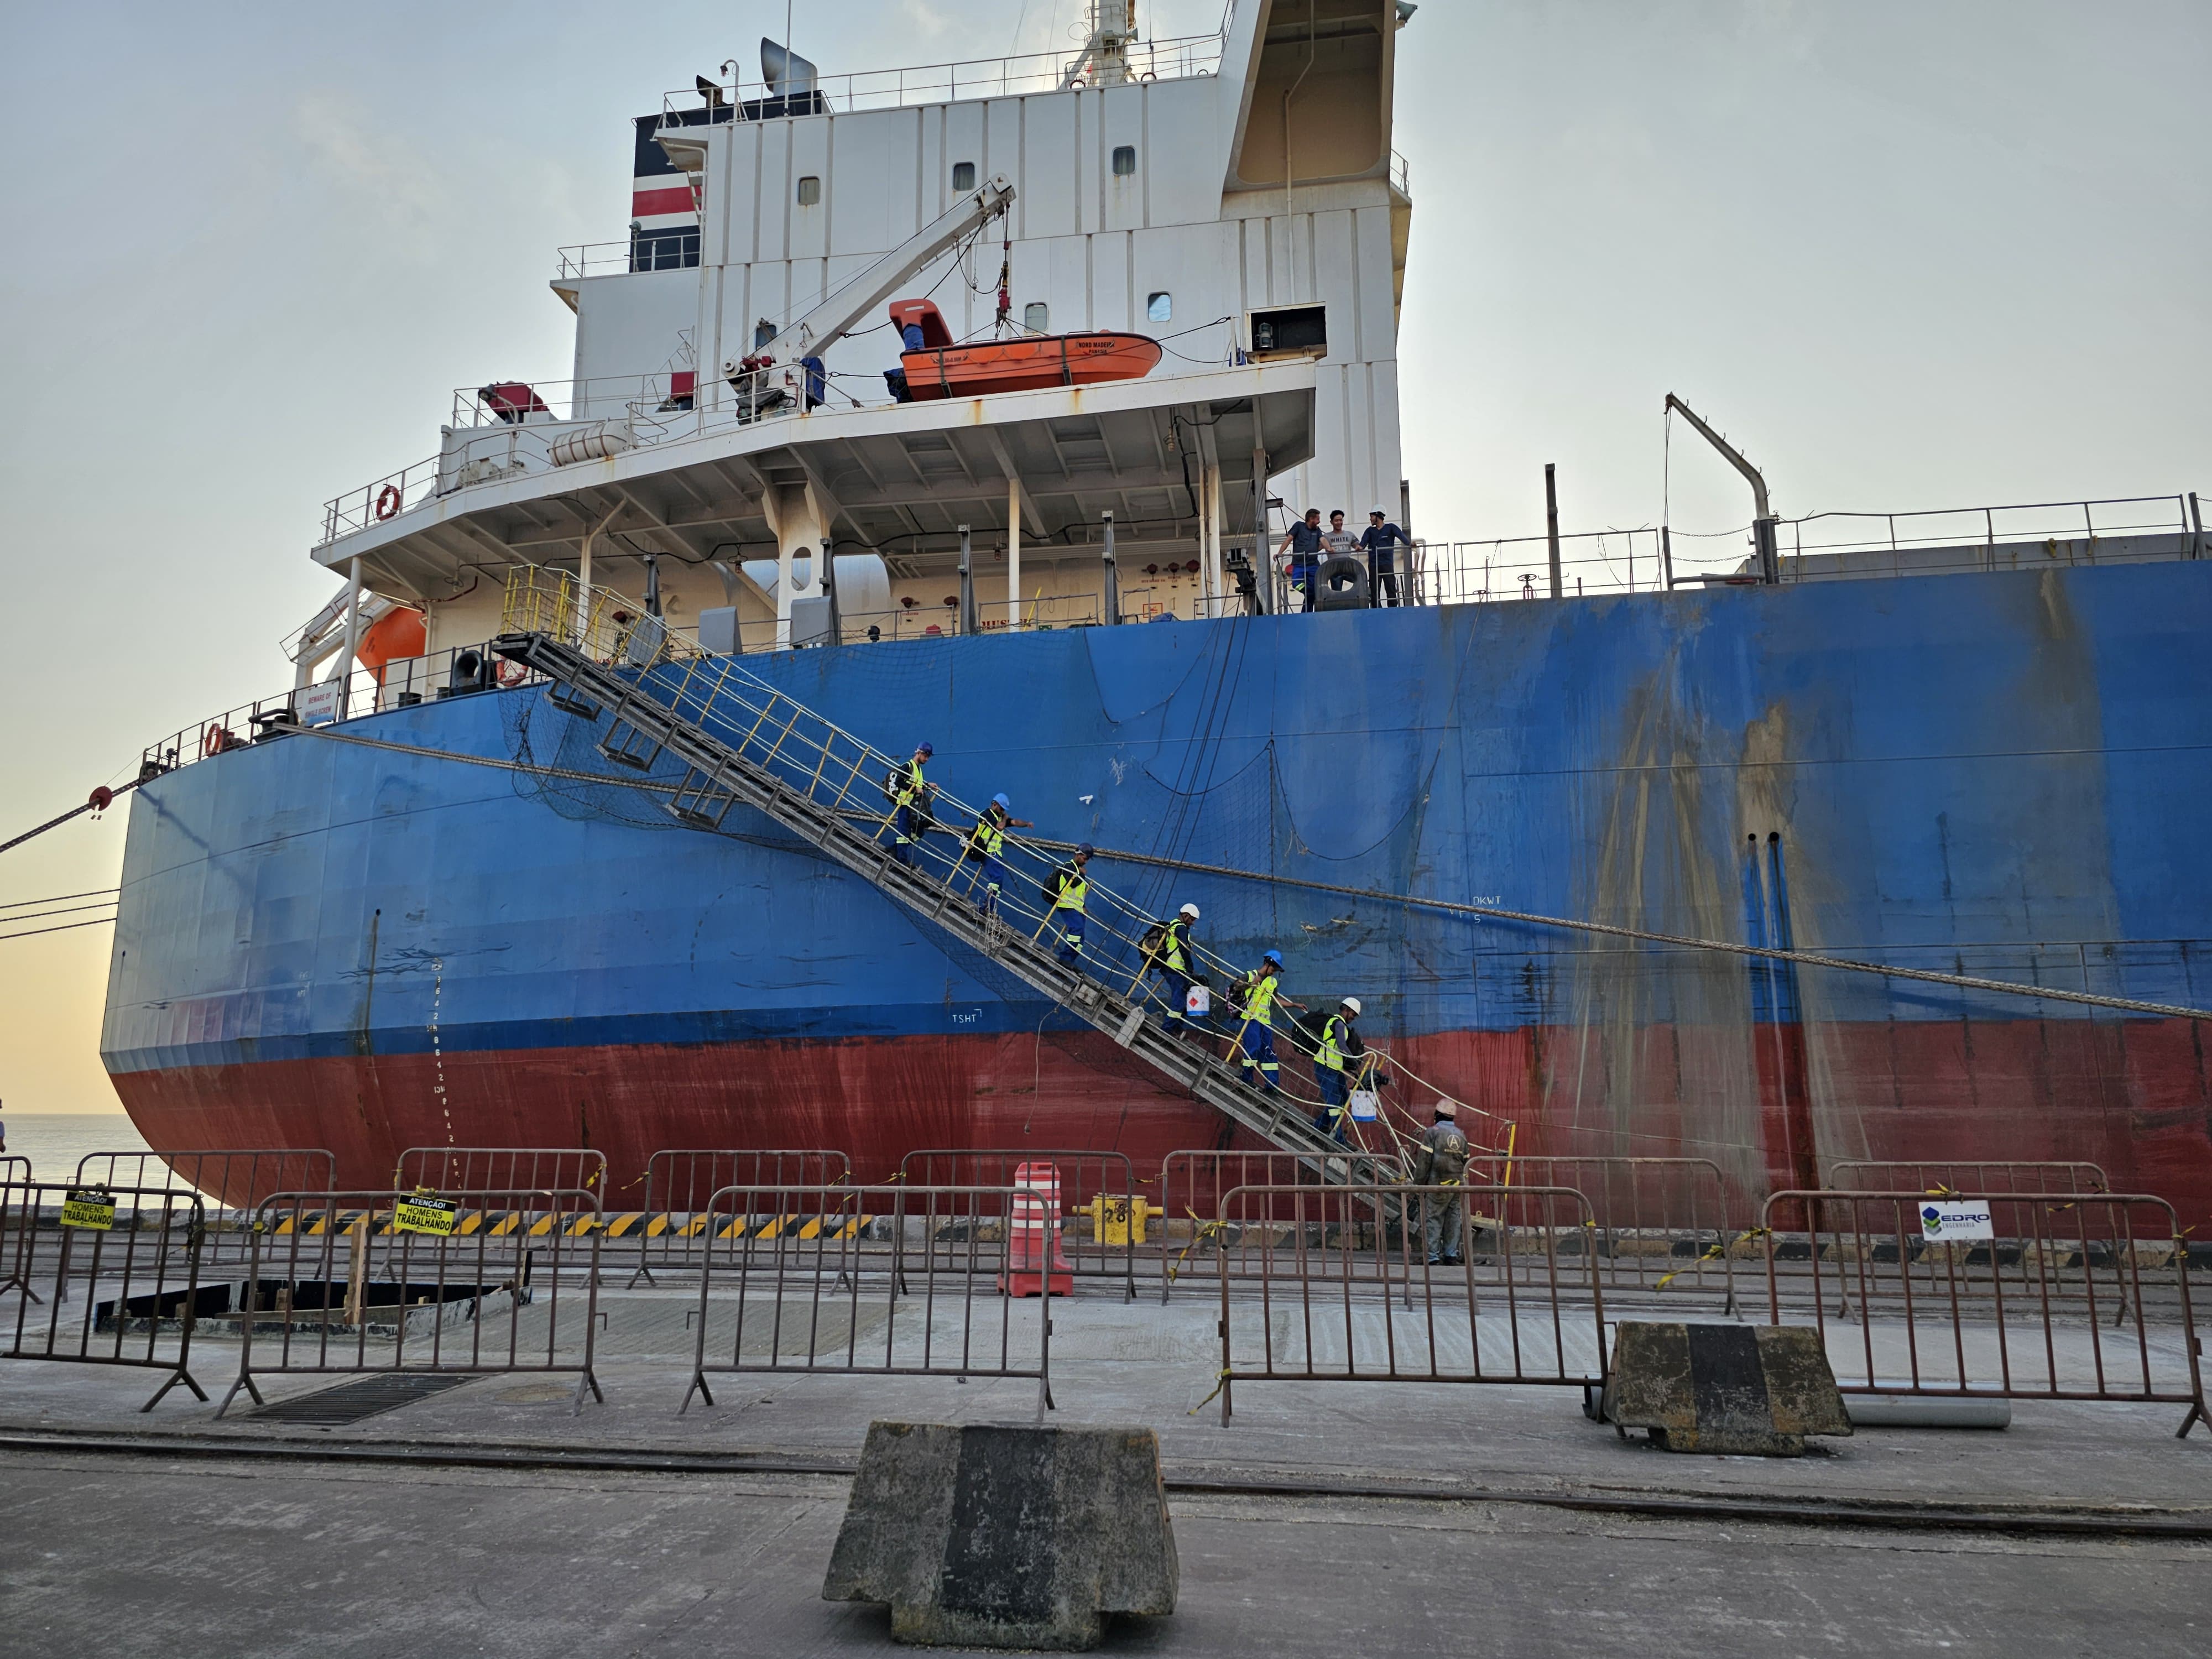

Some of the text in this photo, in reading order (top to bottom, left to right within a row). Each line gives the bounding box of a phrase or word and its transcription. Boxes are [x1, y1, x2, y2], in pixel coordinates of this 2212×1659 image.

[1473, 896, 1501, 905] DKWT
[1474, 914, 1481, 924] 5
[952, 1014, 977, 1023] TSHT
[71, 1203, 105, 1214] HOMENS
[406, 1206, 443, 1219] HOMENS
[64, 1210, 112, 1225] TRABALHANDO
[397, 1213, 451, 1231] TRABALHANDO
[1941, 1214, 1990, 1223] EDRO
